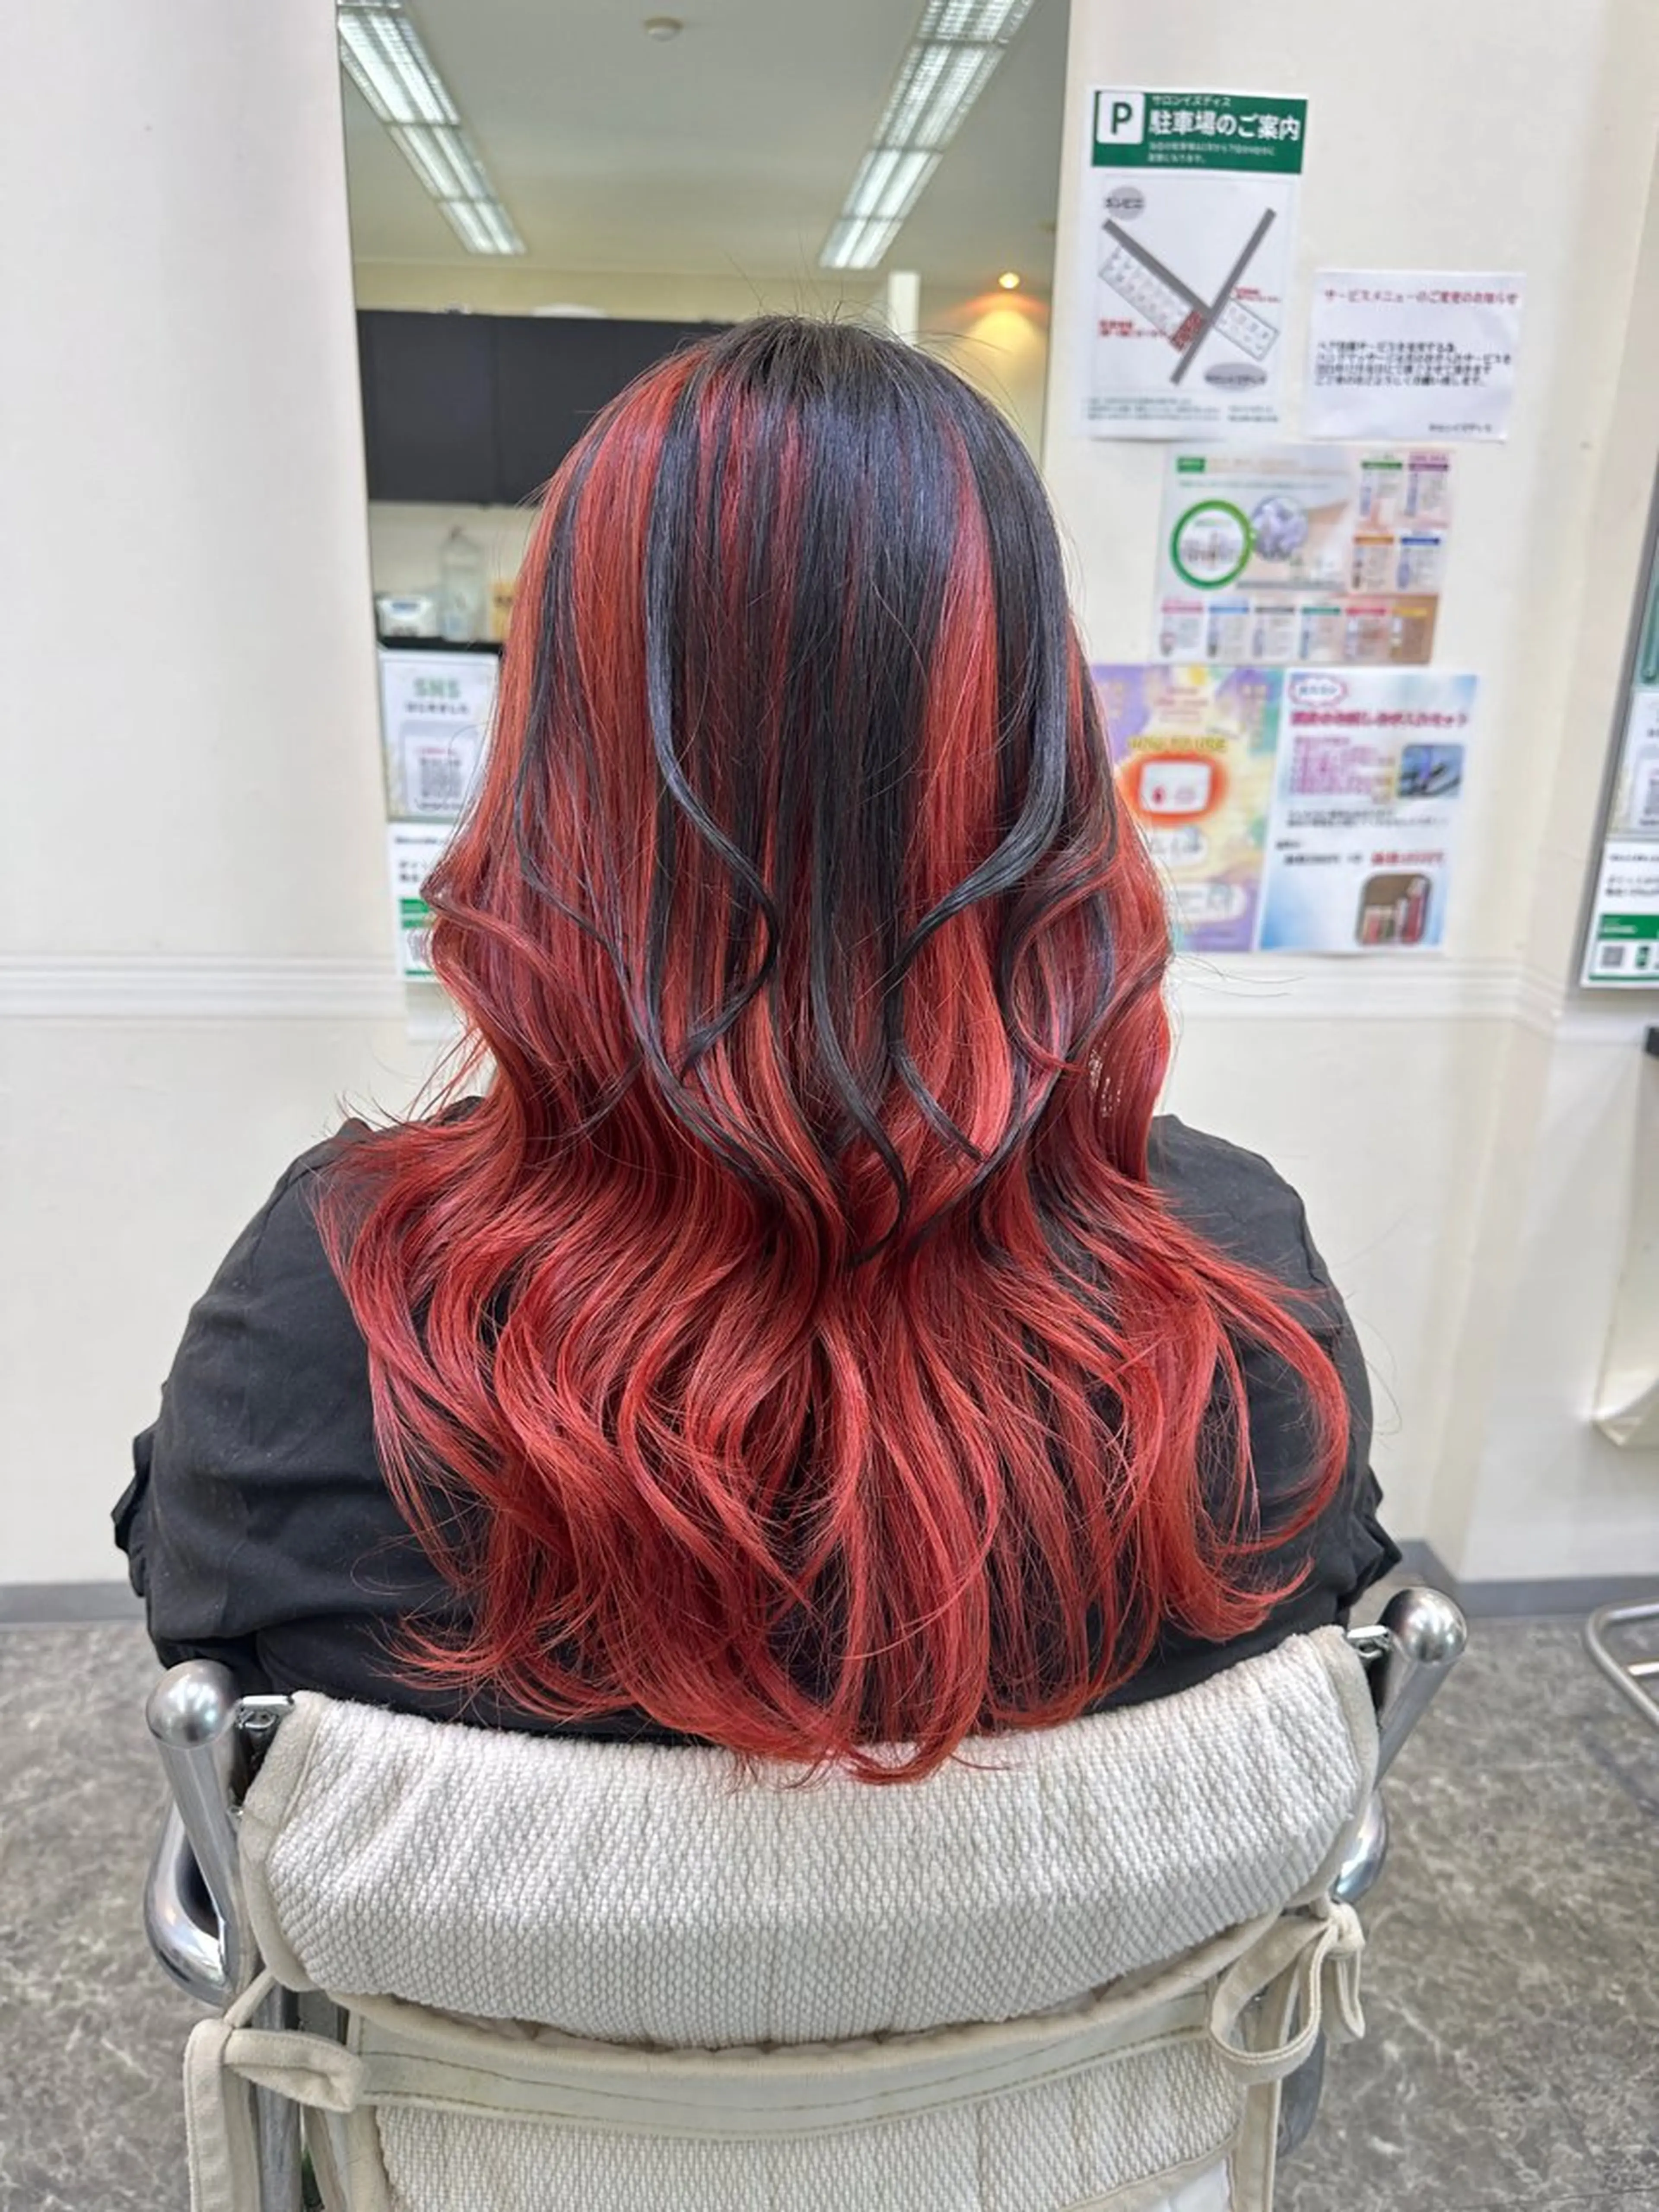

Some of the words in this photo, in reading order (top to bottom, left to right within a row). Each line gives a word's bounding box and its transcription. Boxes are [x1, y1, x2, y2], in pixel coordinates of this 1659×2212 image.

[1110, 102, 1132, 135] P
[1149, 109, 1300, 141] 駐車場のご案内
